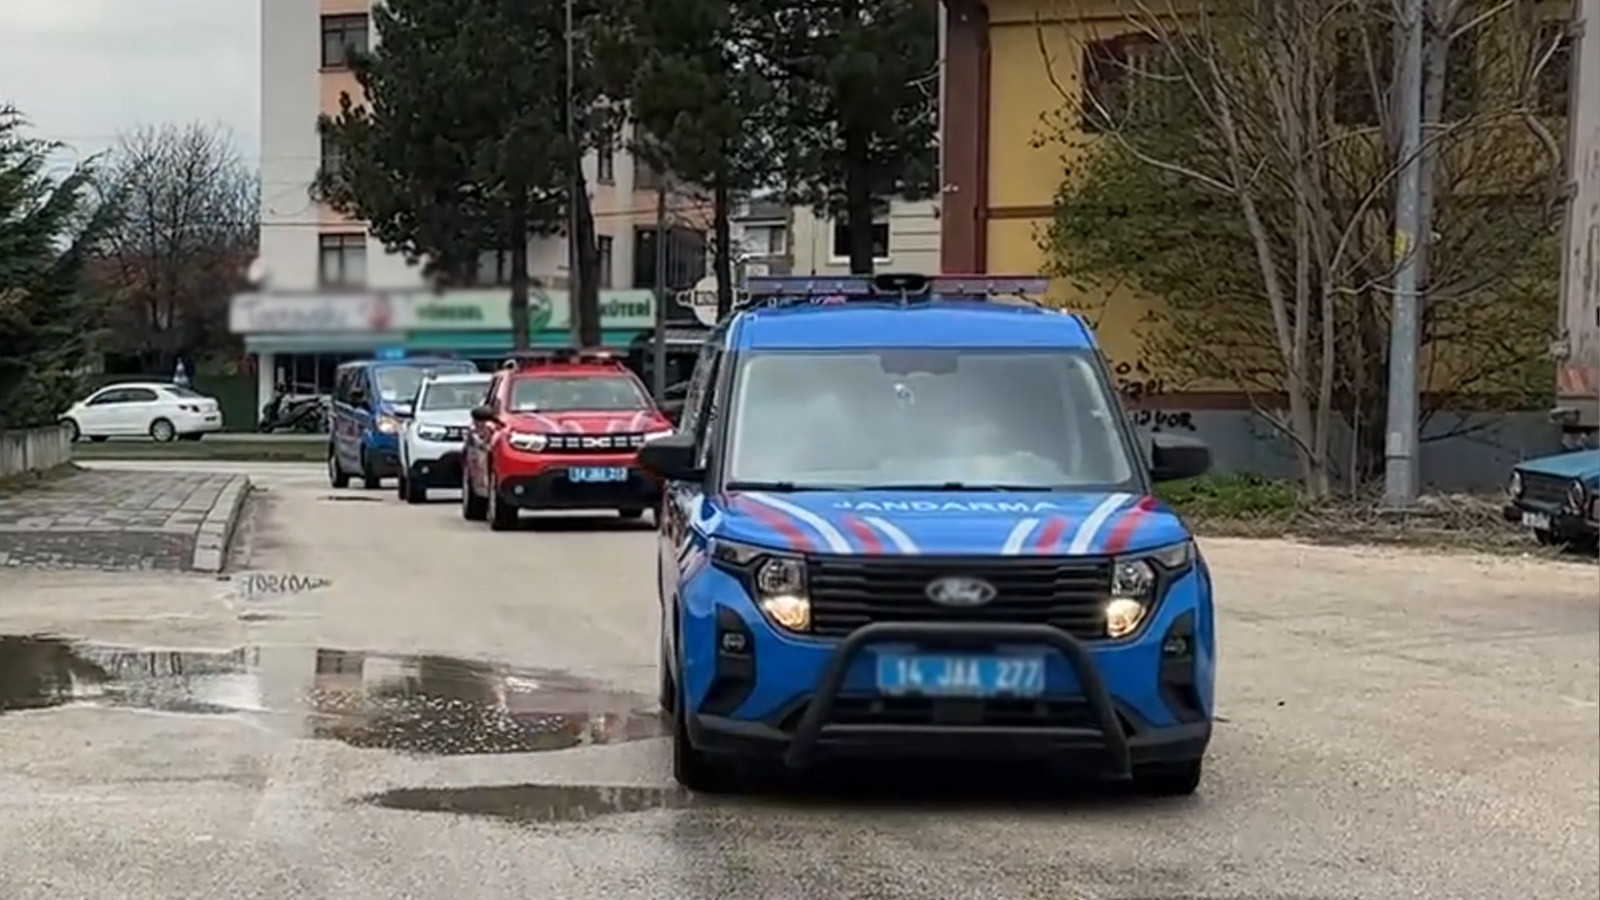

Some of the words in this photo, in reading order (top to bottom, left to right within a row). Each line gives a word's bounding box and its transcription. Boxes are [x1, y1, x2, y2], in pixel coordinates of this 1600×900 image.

[834, 500, 1059, 512] JANDARMA
[932, 578, 990, 604] Ford
[897, 658, 923, 687] 14
[937, 658, 980, 687] JAA
[996, 660, 1039, 688] 277
